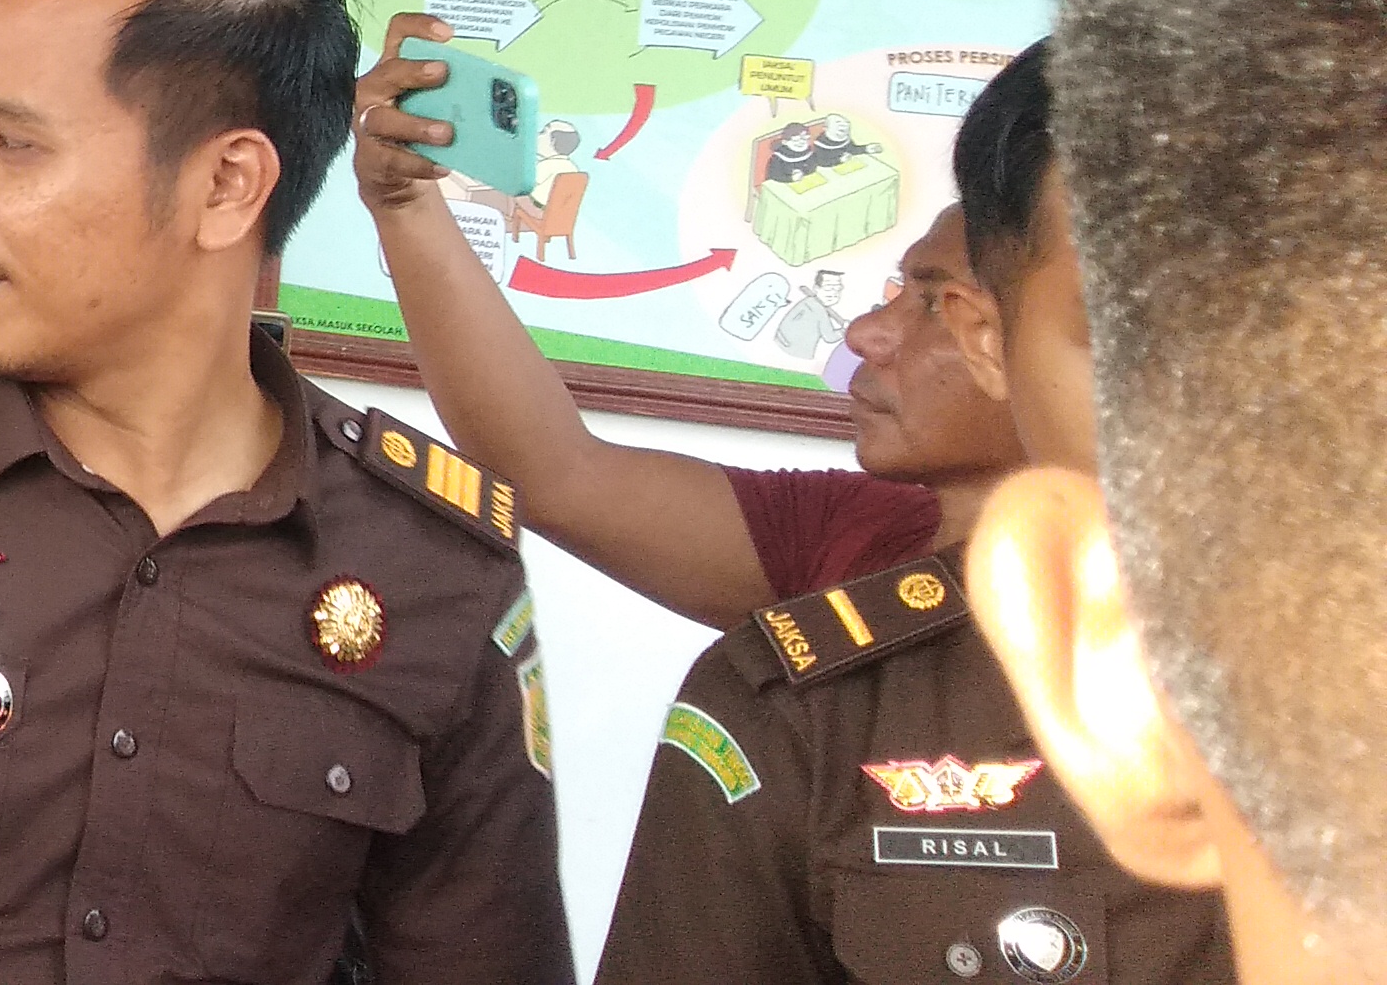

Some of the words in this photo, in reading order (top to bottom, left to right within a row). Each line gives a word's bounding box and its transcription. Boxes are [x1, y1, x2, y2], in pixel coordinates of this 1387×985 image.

[888, 50, 953, 66] PROSES
[317, 319, 353, 330] MASUK
[356, 323, 402, 335] SEKOLAH
[764, 609, 819, 672] JAKSA
[921, 838, 1009, 858] RISAL
